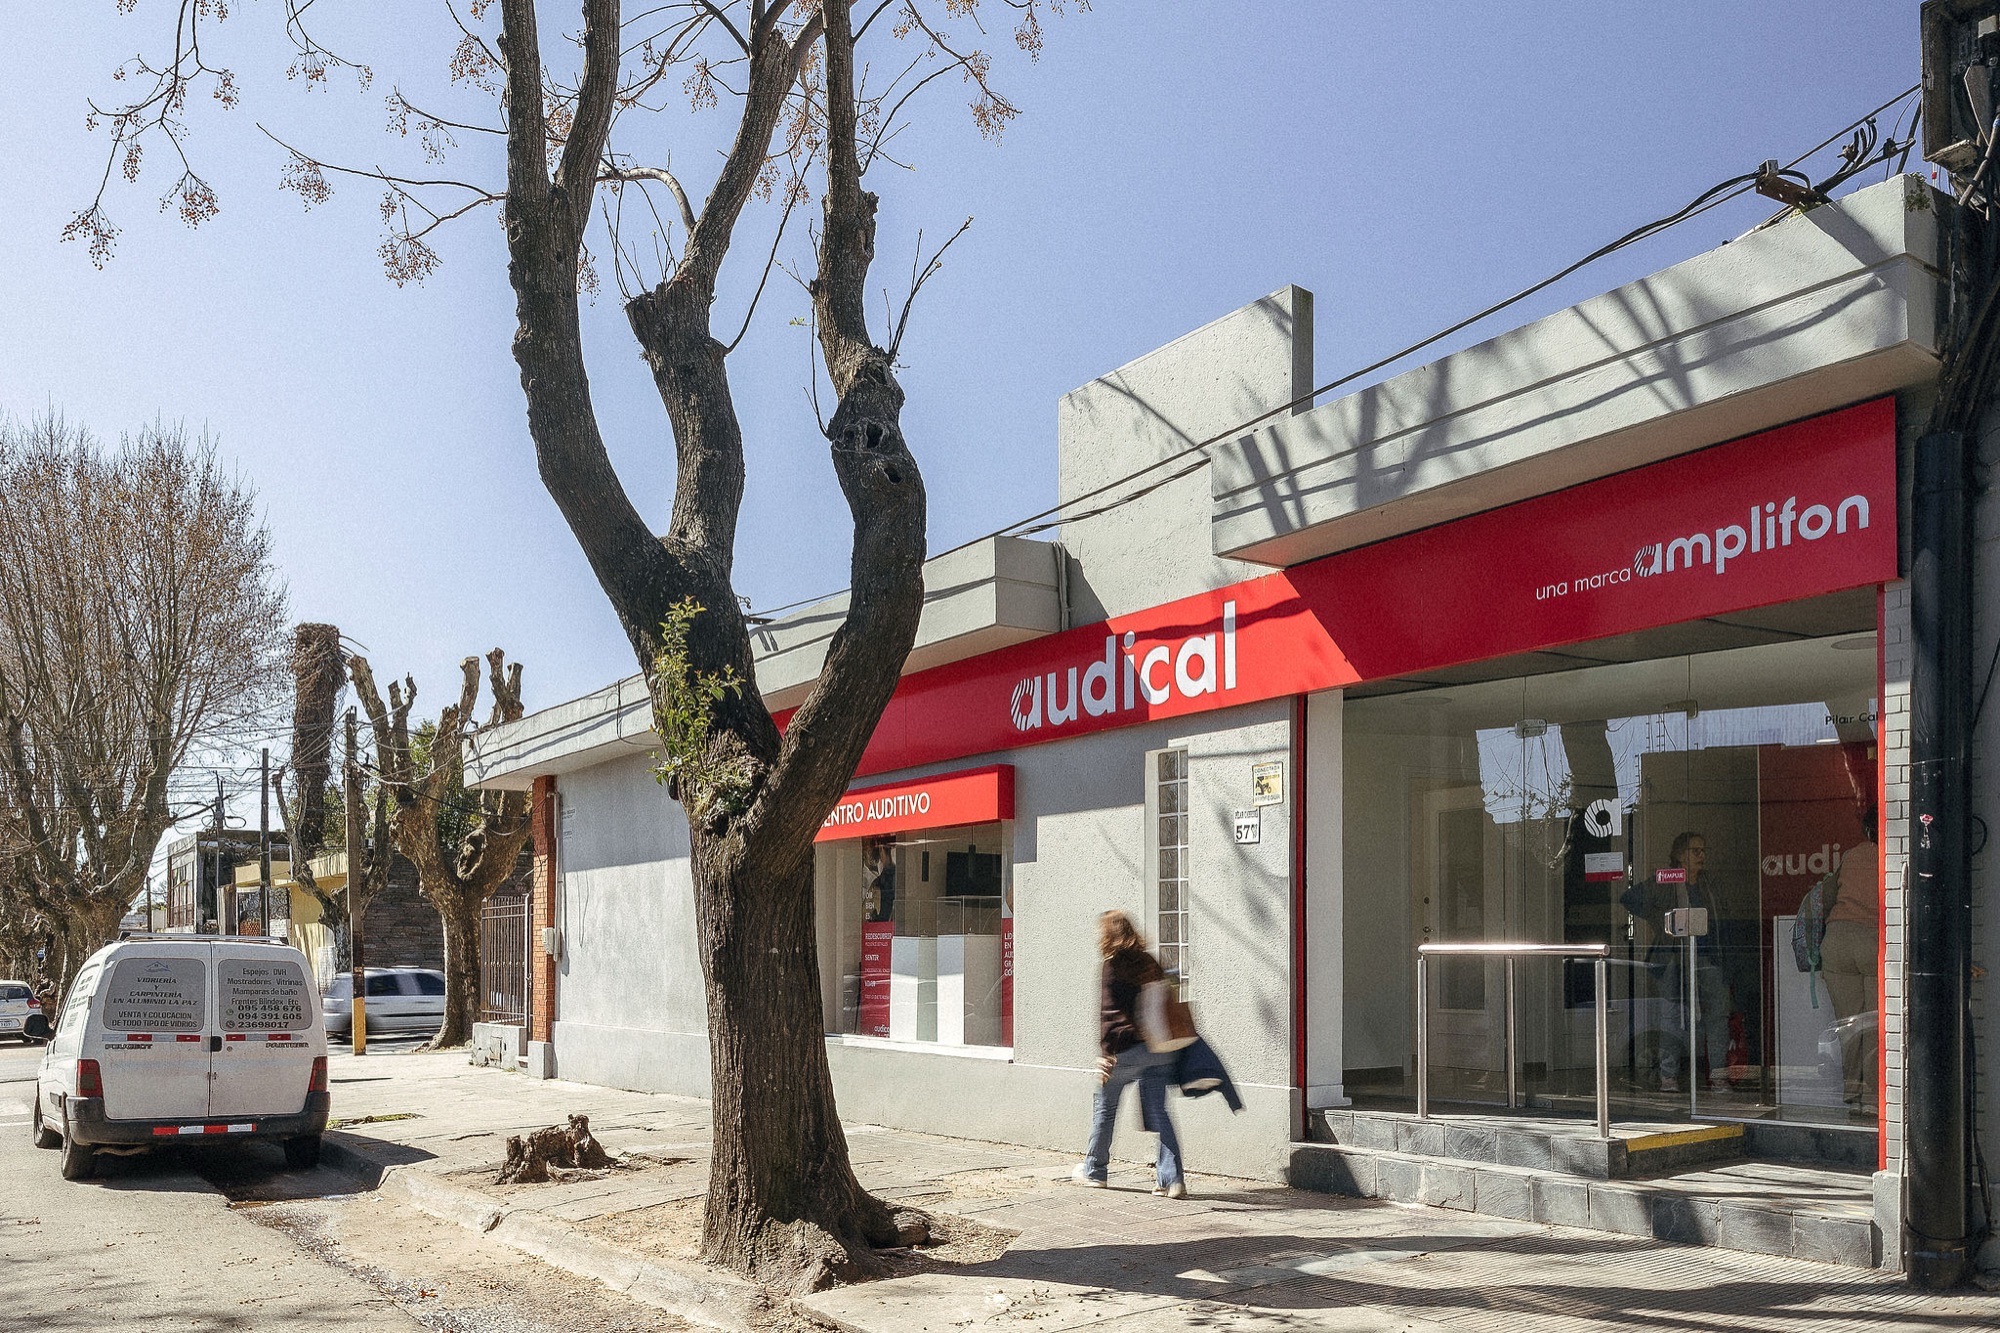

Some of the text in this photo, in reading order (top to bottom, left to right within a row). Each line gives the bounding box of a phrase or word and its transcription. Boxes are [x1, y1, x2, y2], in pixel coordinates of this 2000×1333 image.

[1535, 494, 1870, 600] una marca amplifon
[1010, 599, 1237, 732] audical
[867, 791, 931, 821] AUDITIVO
[242, 968, 270, 976] Espejos
[232, 988, 270, 996] Mamparas
[280, 988, 298, 996] baño
[170, 1020, 198, 1028] VIDRIOS
